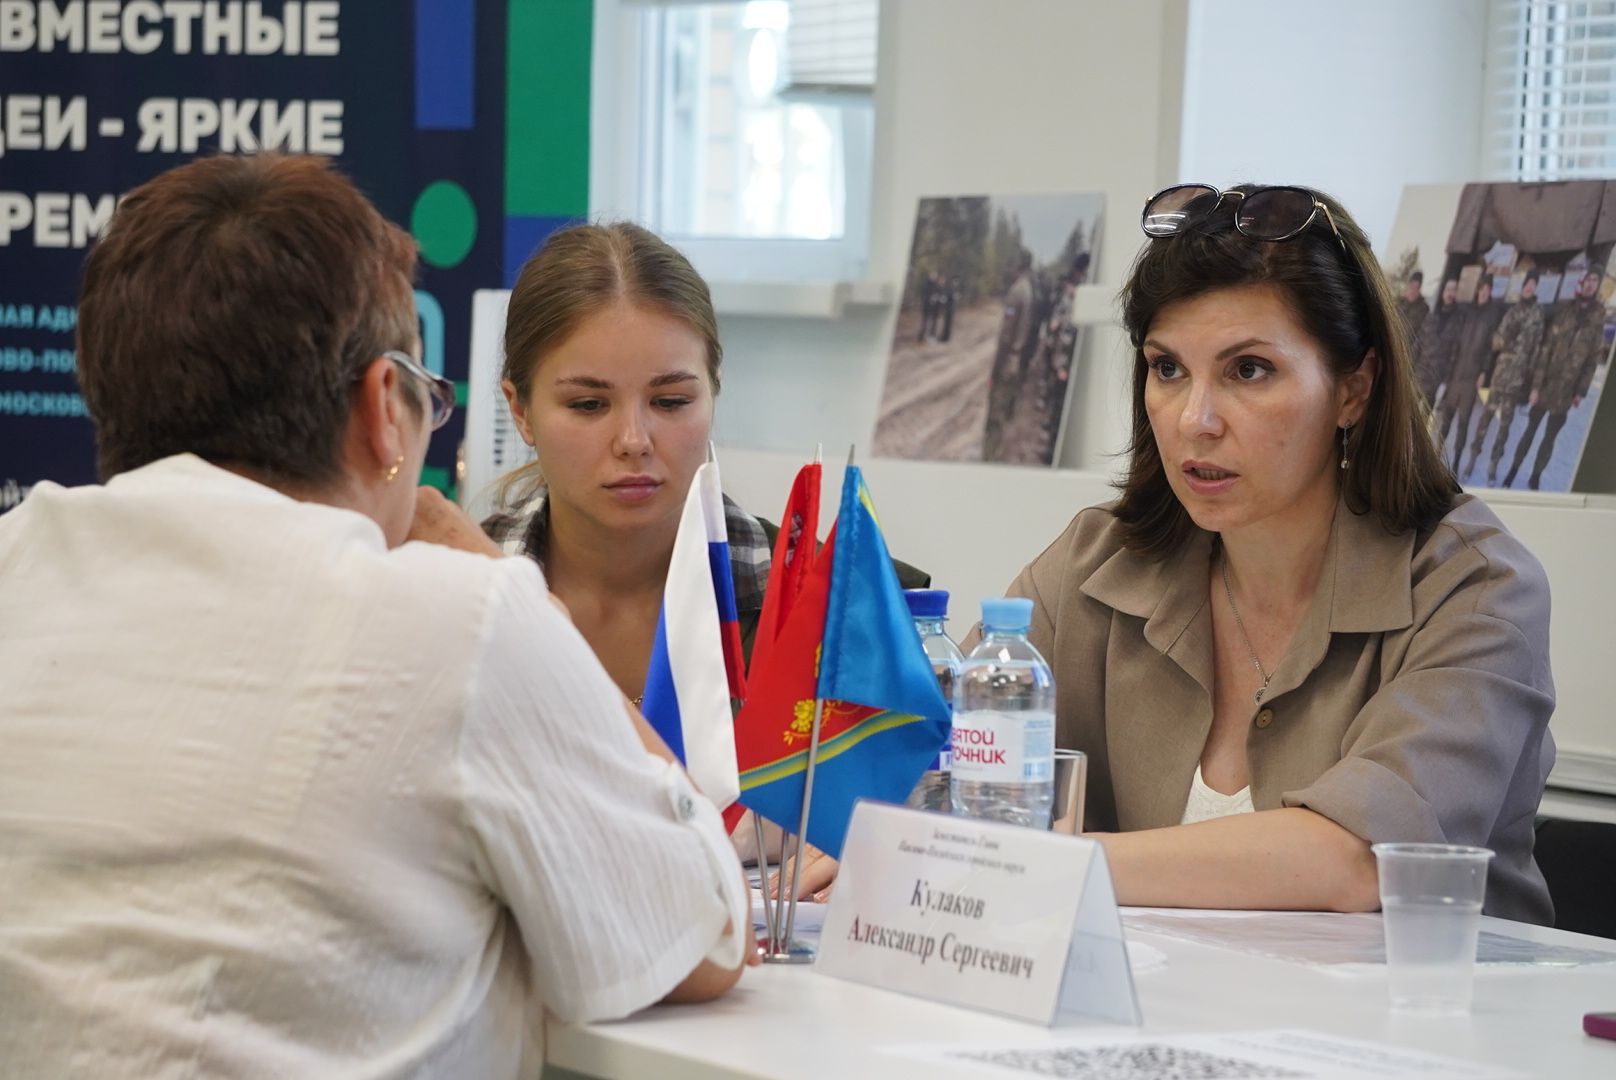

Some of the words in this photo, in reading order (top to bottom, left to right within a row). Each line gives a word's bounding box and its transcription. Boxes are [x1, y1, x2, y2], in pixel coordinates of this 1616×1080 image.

[0, 0, 340, 55] ВМЕСТНЫЕ
[99, 118, 124, 136] -
[137, 97, 344, 155] ЯРКИЕ
[0, 190, 123, 249] РЕМ
[910, 878, 985, 919] Кулаков
[848, 914, 936, 965] Александр
[939, 932, 1035, 980] Сергеевич
